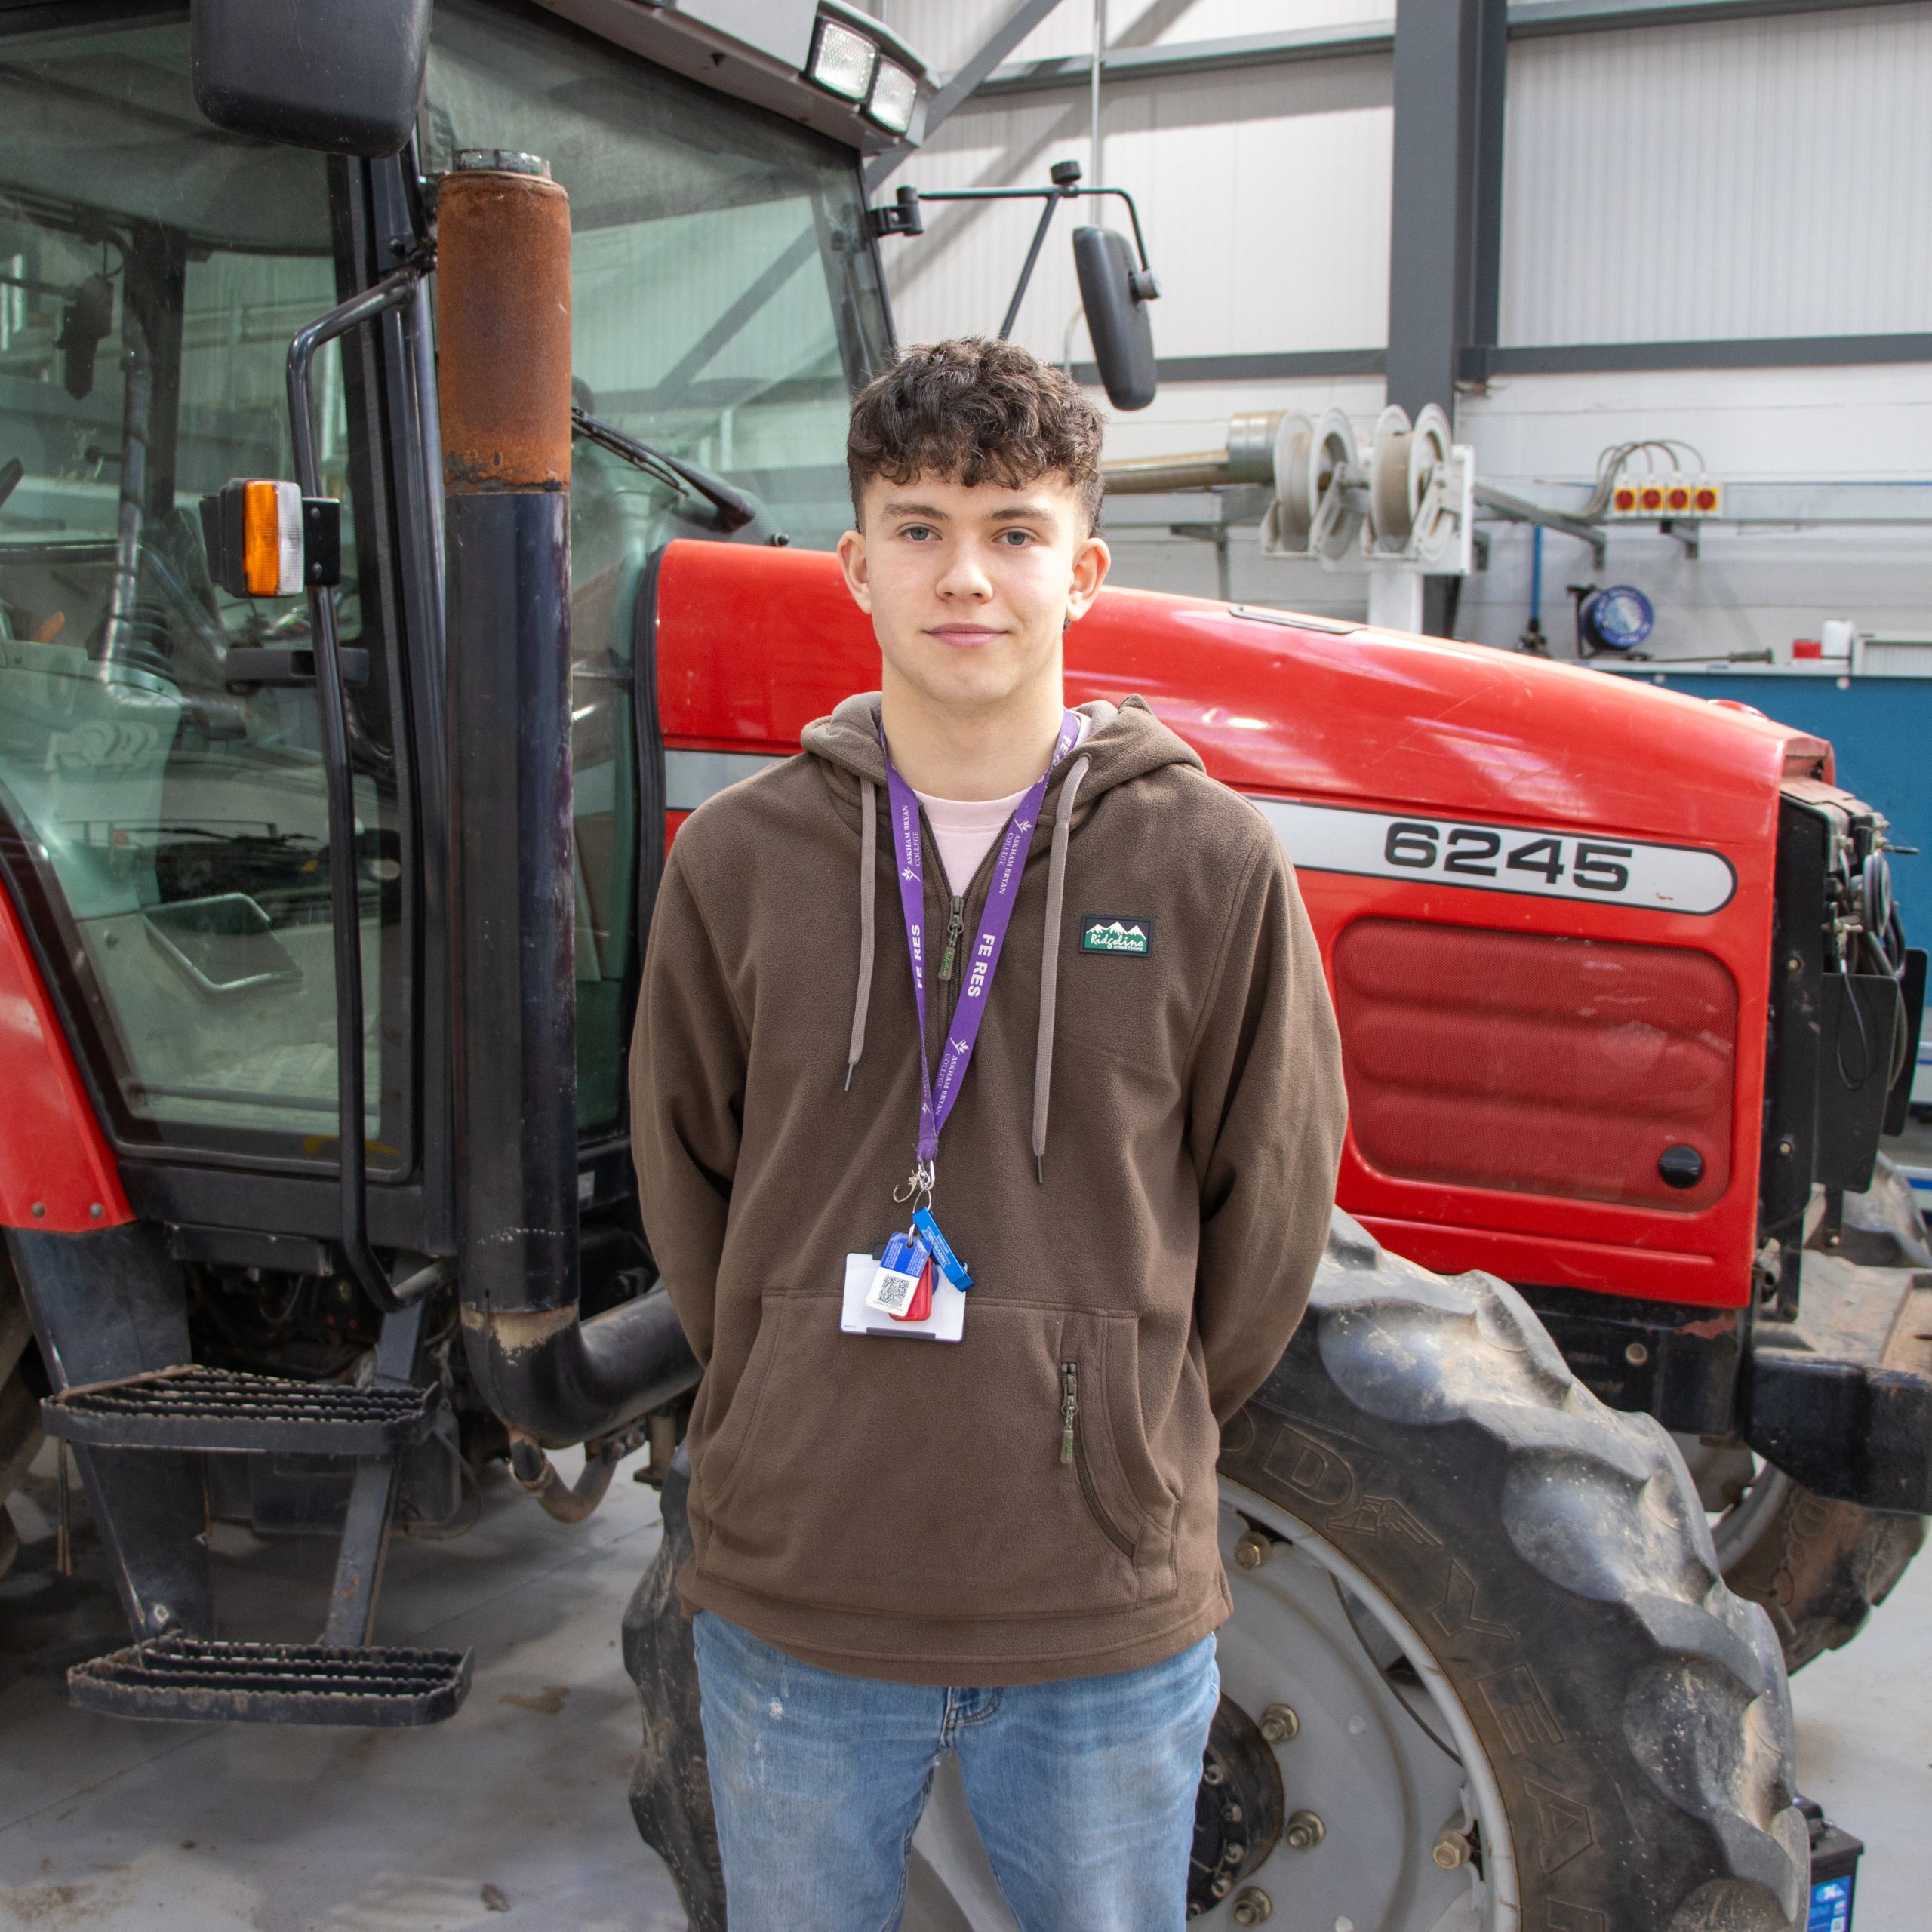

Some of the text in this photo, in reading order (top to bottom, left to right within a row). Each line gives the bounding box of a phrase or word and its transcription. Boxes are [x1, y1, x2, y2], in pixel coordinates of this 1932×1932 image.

[1060, 734, 1072, 756] FE
[902, 804, 914, 866] ASKHAM BRYAN
[912, 832, 921, 867] COLLEGE
[998, 832, 1014, 866] COLLEGE
[999, 834, 1021, 894] ASKHAM BRYAN
[1384, 821, 1633, 892] 6245
[911, 924, 923, 989] FE RES
[967, 934, 996, 998] FE RES
[1091, 933, 1143, 949] Ridgeline
[935, 1054, 958, 1115] ASKHAM BRYAN
[937, 1053, 951, 1088] COLLEGE
